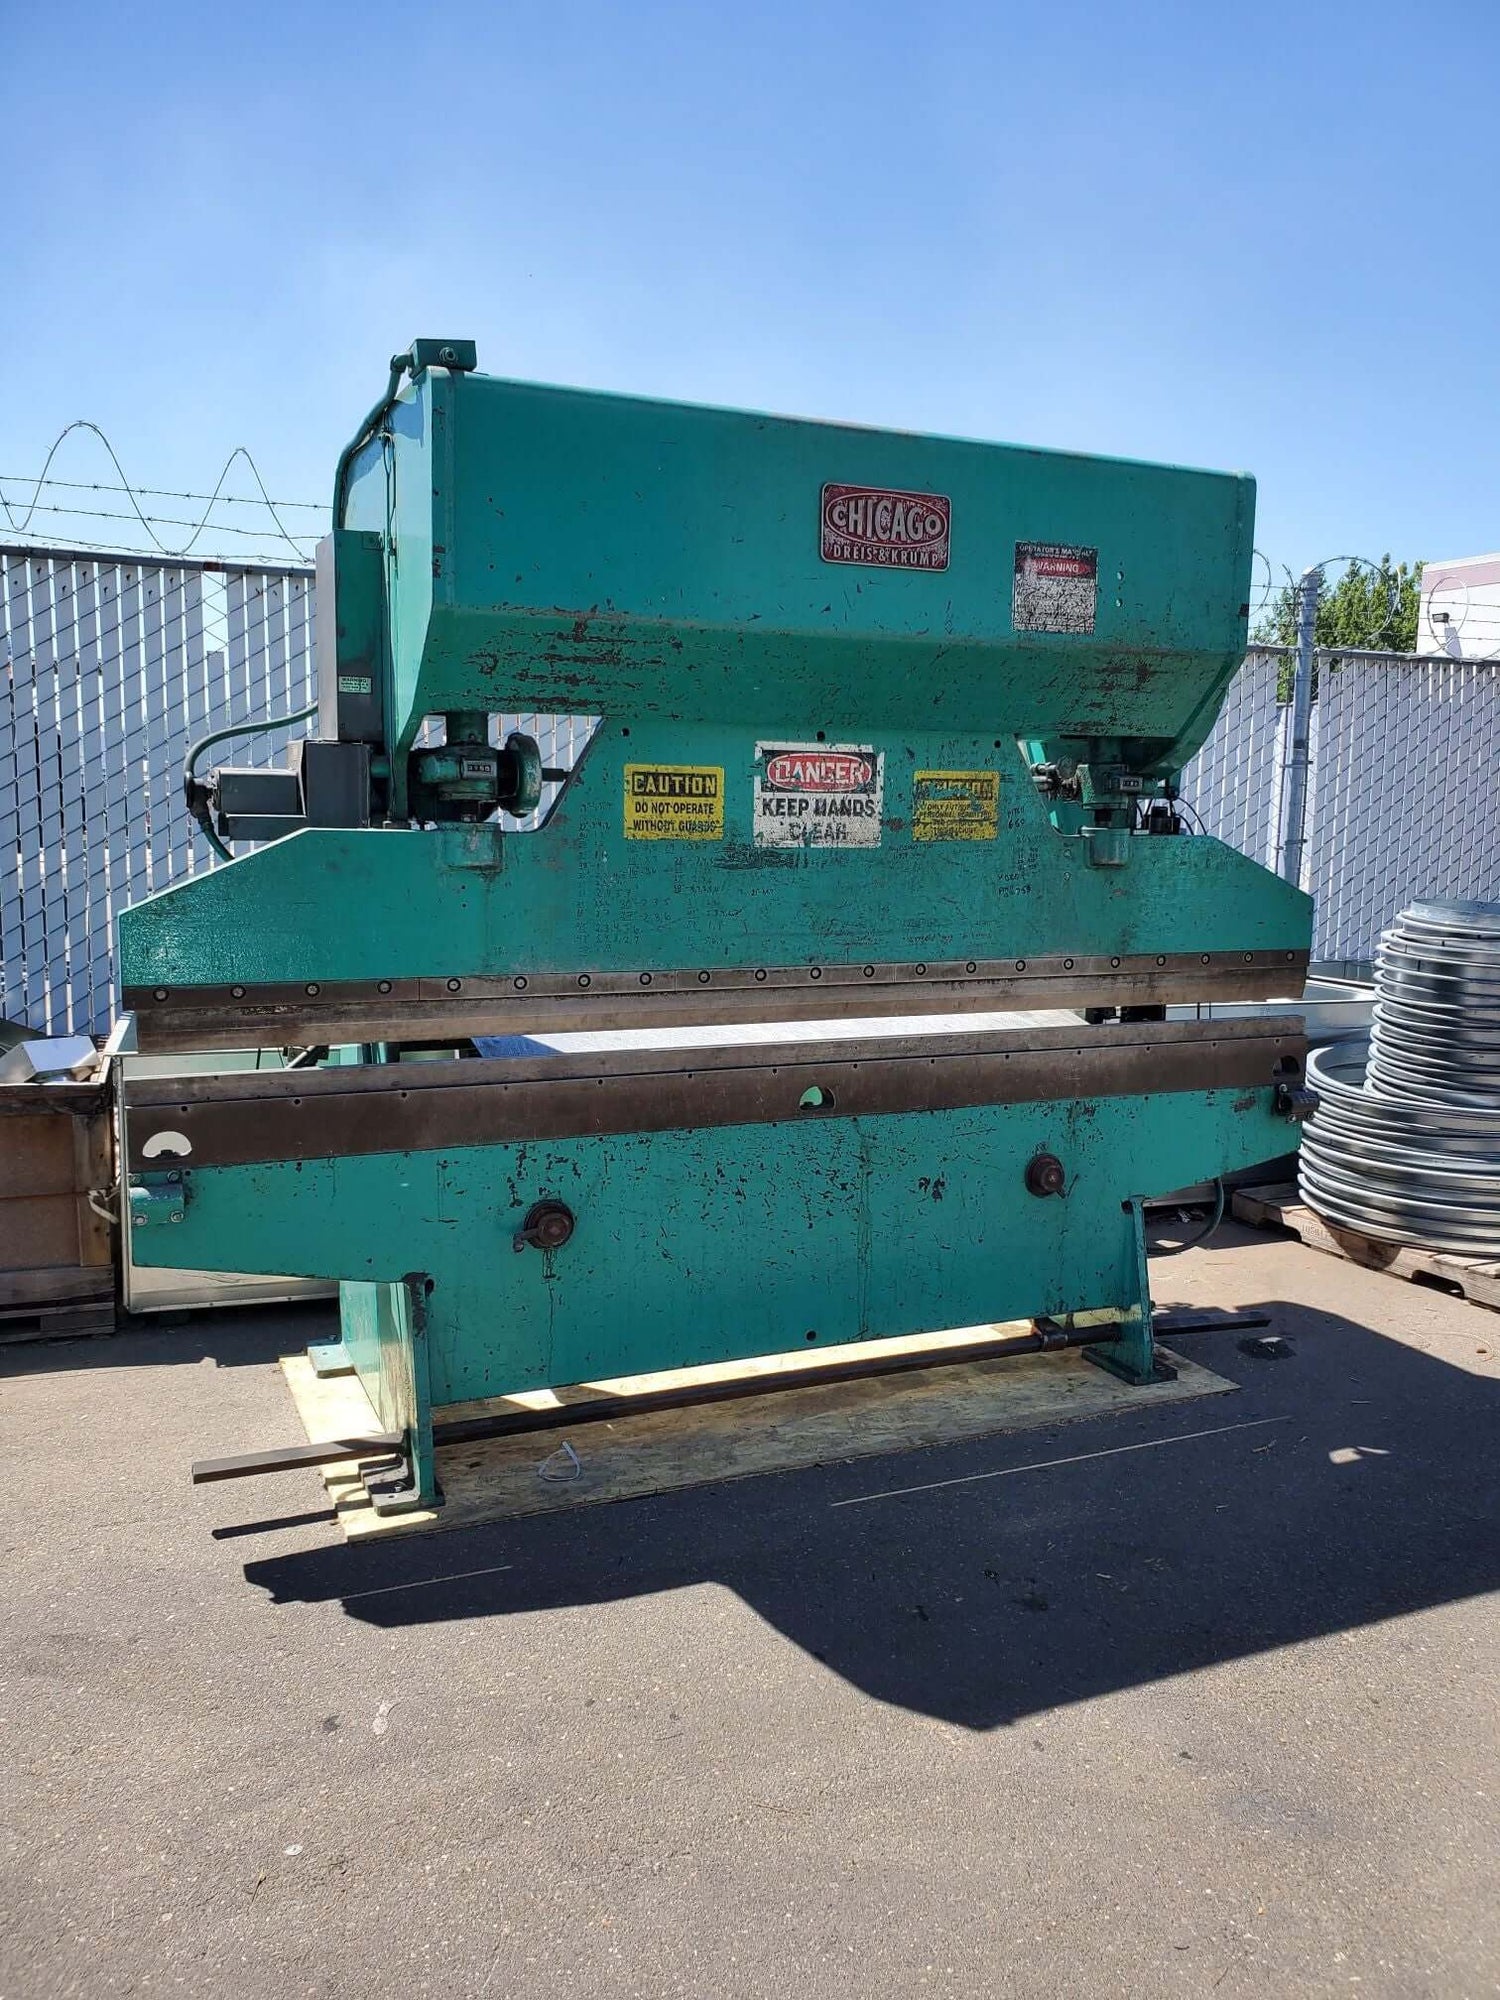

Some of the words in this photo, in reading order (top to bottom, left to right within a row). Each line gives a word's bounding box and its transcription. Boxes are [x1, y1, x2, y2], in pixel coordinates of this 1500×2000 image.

[832, 499, 942, 541] CHICAGO
[833, 544, 873, 561] DREIS
[878, 548, 888, 562] &
[892, 549, 939, 566] KRUMP
[775, 760, 865, 785] DANGER
[633, 774, 717, 795] CAUTION
[635, 802, 649, 814] DO
[651, 802, 671, 815] NOT
[673, 802, 715, 816] OPERATE
[762, 798, 810, 817] KEEP
[813, 798, 877, 818] HANDS
[633, 819, 676, 833] WITHOUT
[788, 821, 848, 841] CLEAR
